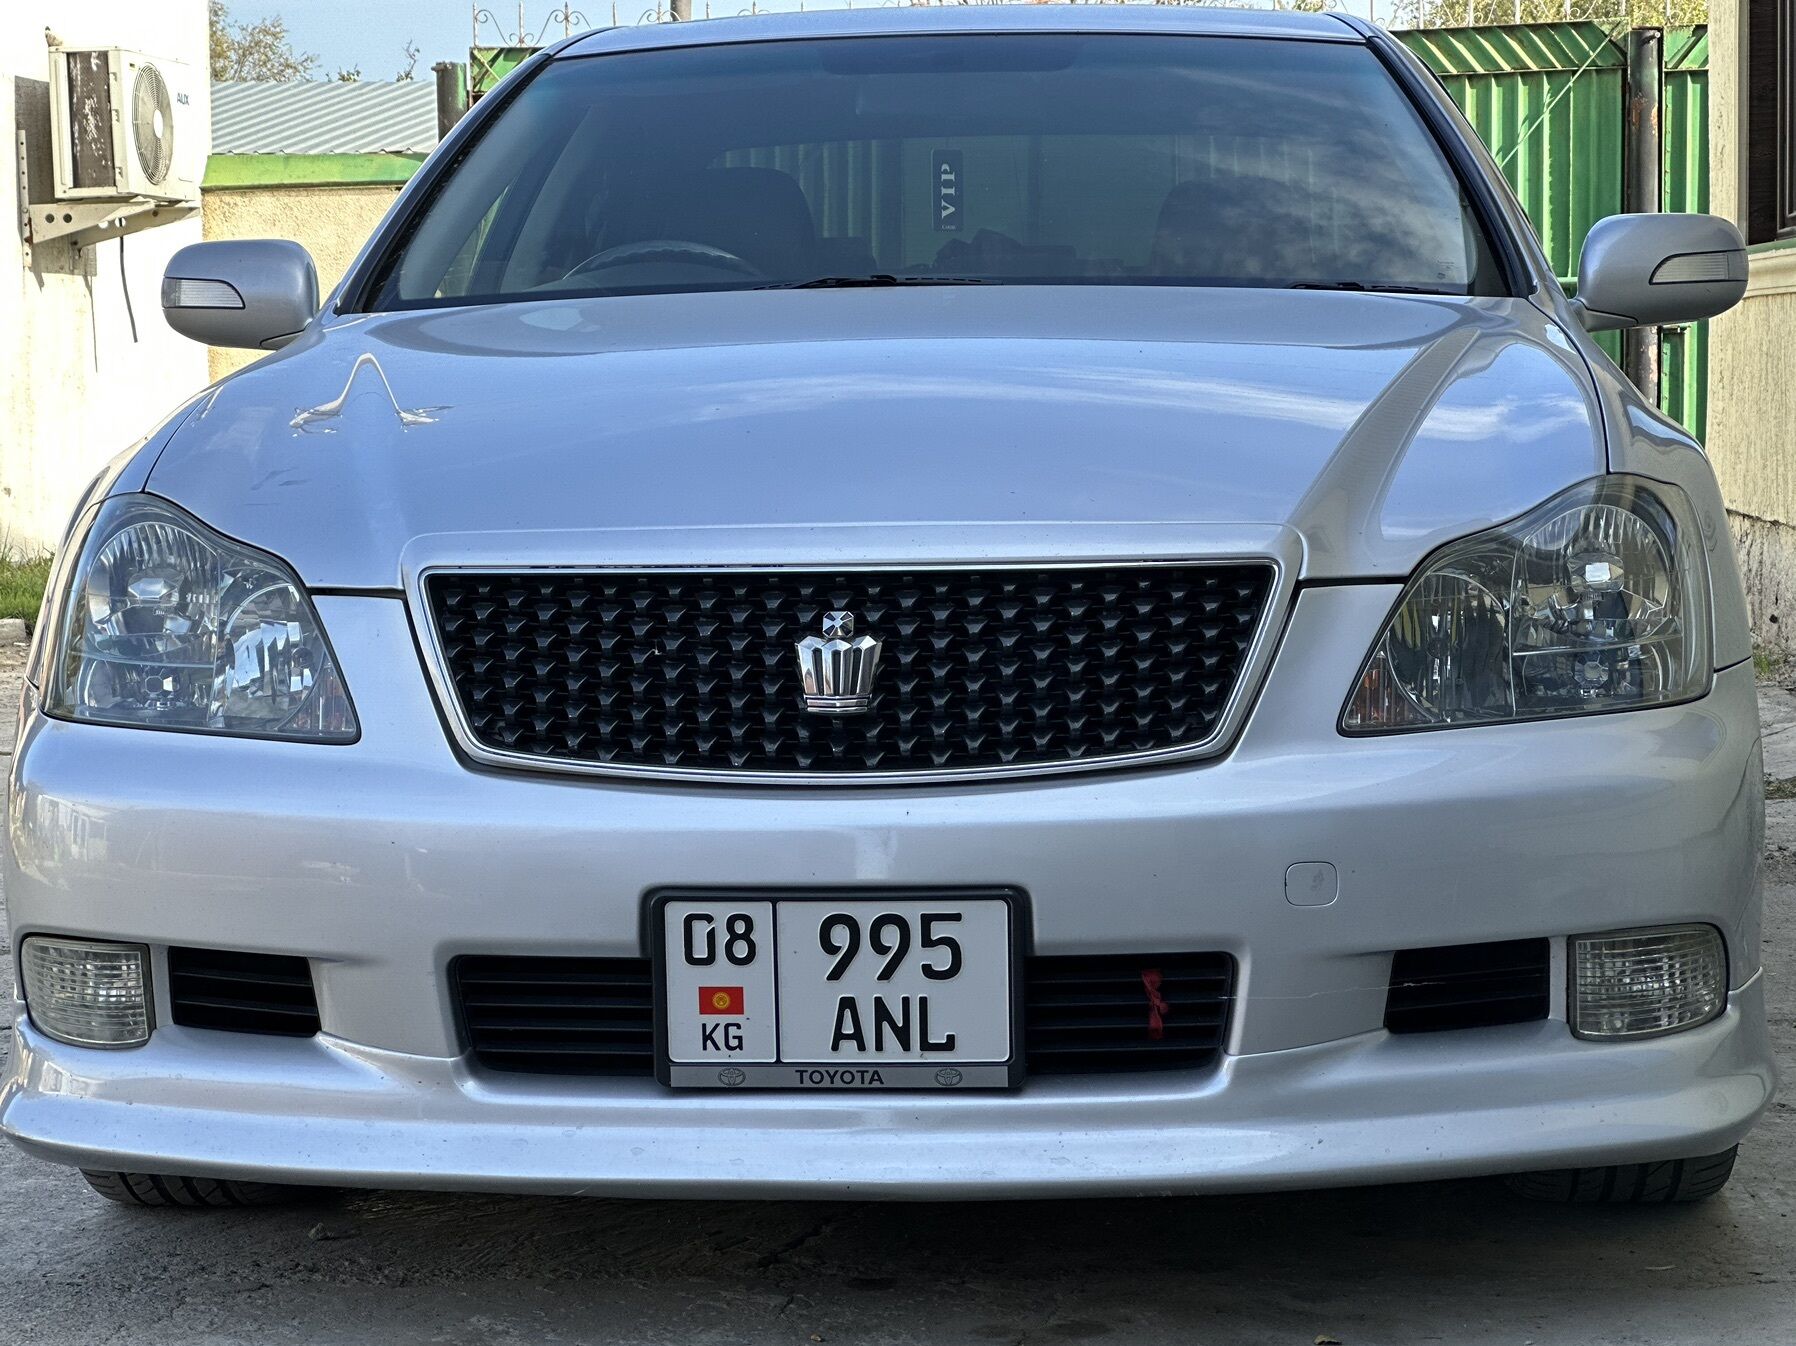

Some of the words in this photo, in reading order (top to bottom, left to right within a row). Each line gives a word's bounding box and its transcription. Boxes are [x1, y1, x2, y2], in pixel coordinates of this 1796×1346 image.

[941, 163, 955, 219] VIP
[683, 913, 756, 966] 08
[818, 912, 963, 981] 995
[701, 1022, 744, 1051] KG
[830, 996, 956, 1052] ANL
[795, 1069, 884, 1085] TOYOTA
